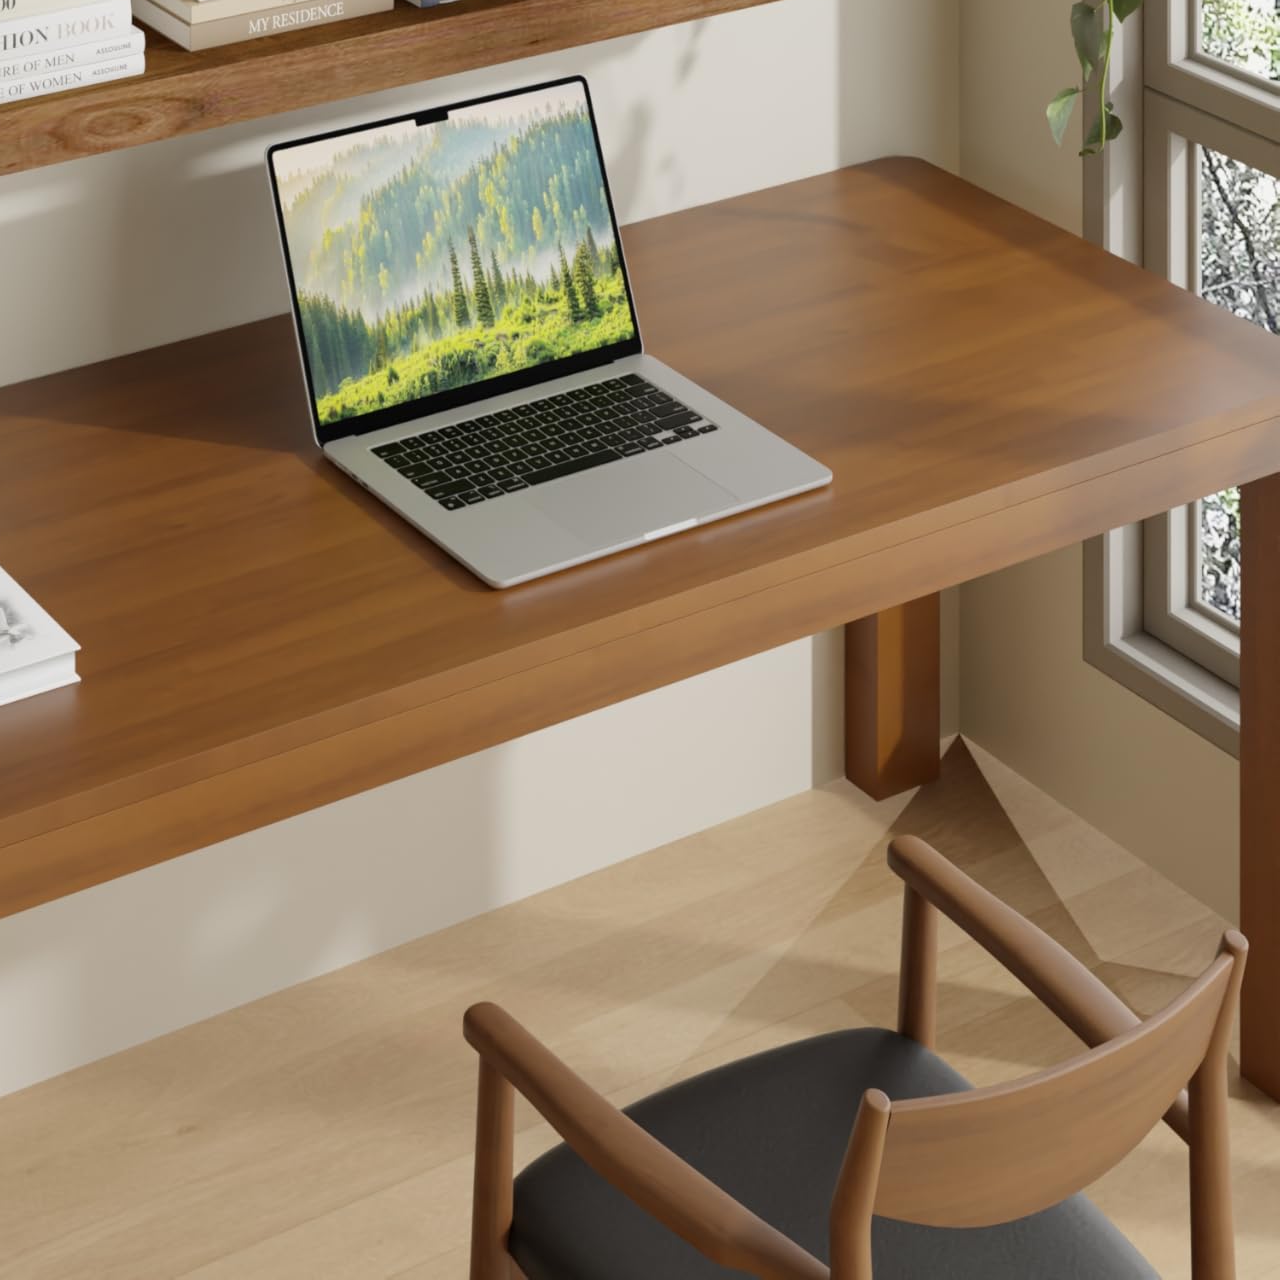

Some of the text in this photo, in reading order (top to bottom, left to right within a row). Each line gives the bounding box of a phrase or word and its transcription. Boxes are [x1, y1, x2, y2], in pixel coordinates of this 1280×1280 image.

[57, 12, 115, 39] BOOK
[249, 2, 344, 35] MY RESIDENCE
[96, 42, 131, 56] ASSOULINE
[23, 60, 41, 72] OF
[44, 53, 75, 68] MEN
[8, 83, 26, 96] OF
[29, 72, 82, 92] WOMEN
